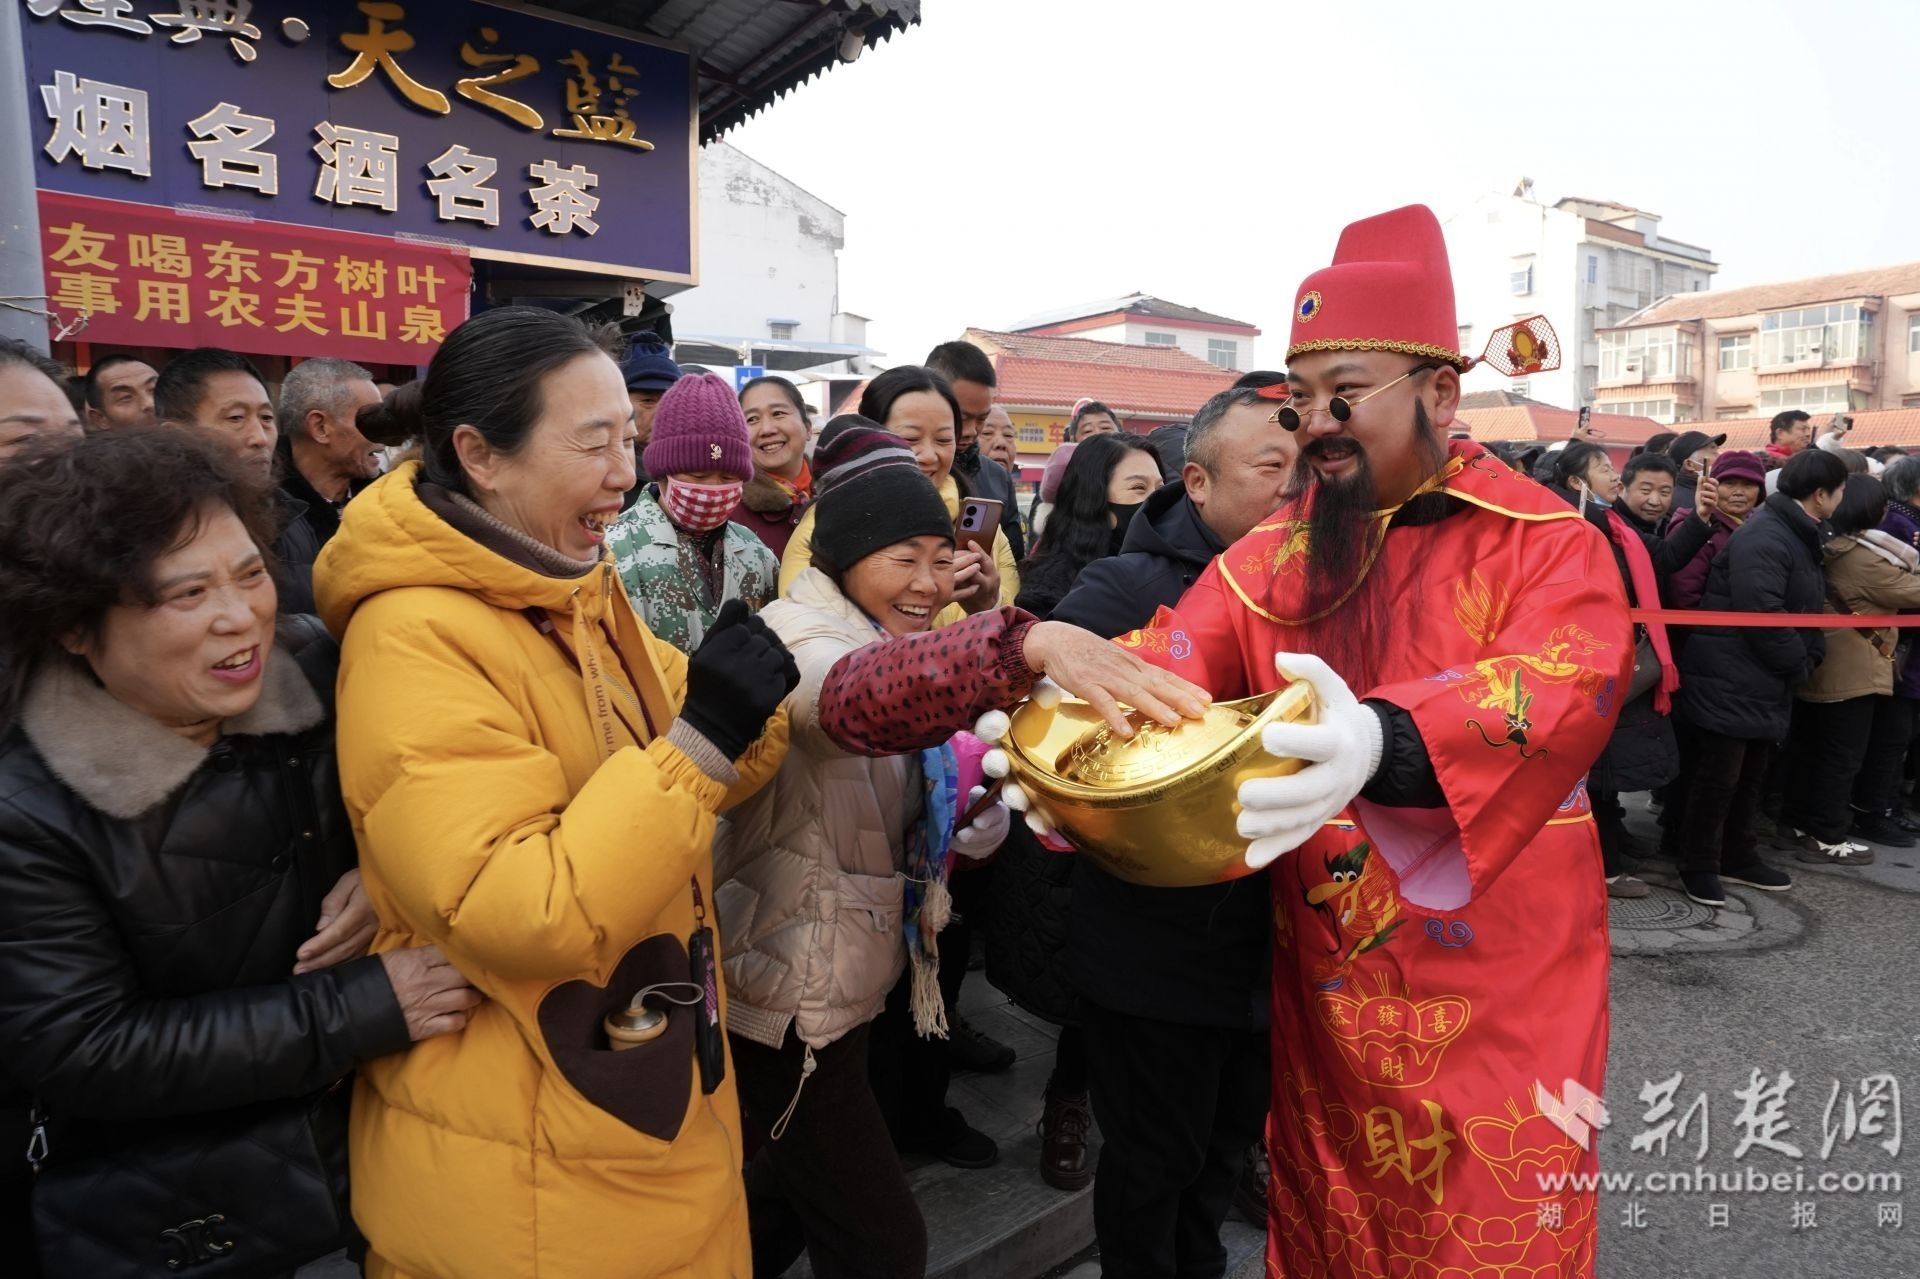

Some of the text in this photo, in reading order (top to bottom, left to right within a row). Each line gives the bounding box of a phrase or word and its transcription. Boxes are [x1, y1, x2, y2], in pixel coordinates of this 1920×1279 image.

[39, 69, 601, 236] 烟名酒名茶
[48, 222, 446, 304] 友喝东方树叶
[50, 270, 446, 345] 事用农夫山泉
[594, 683, 609, 718] from
[1378, 1055, 1405, 1082] 財
[1362, 1100, 1460, 1205] 財
